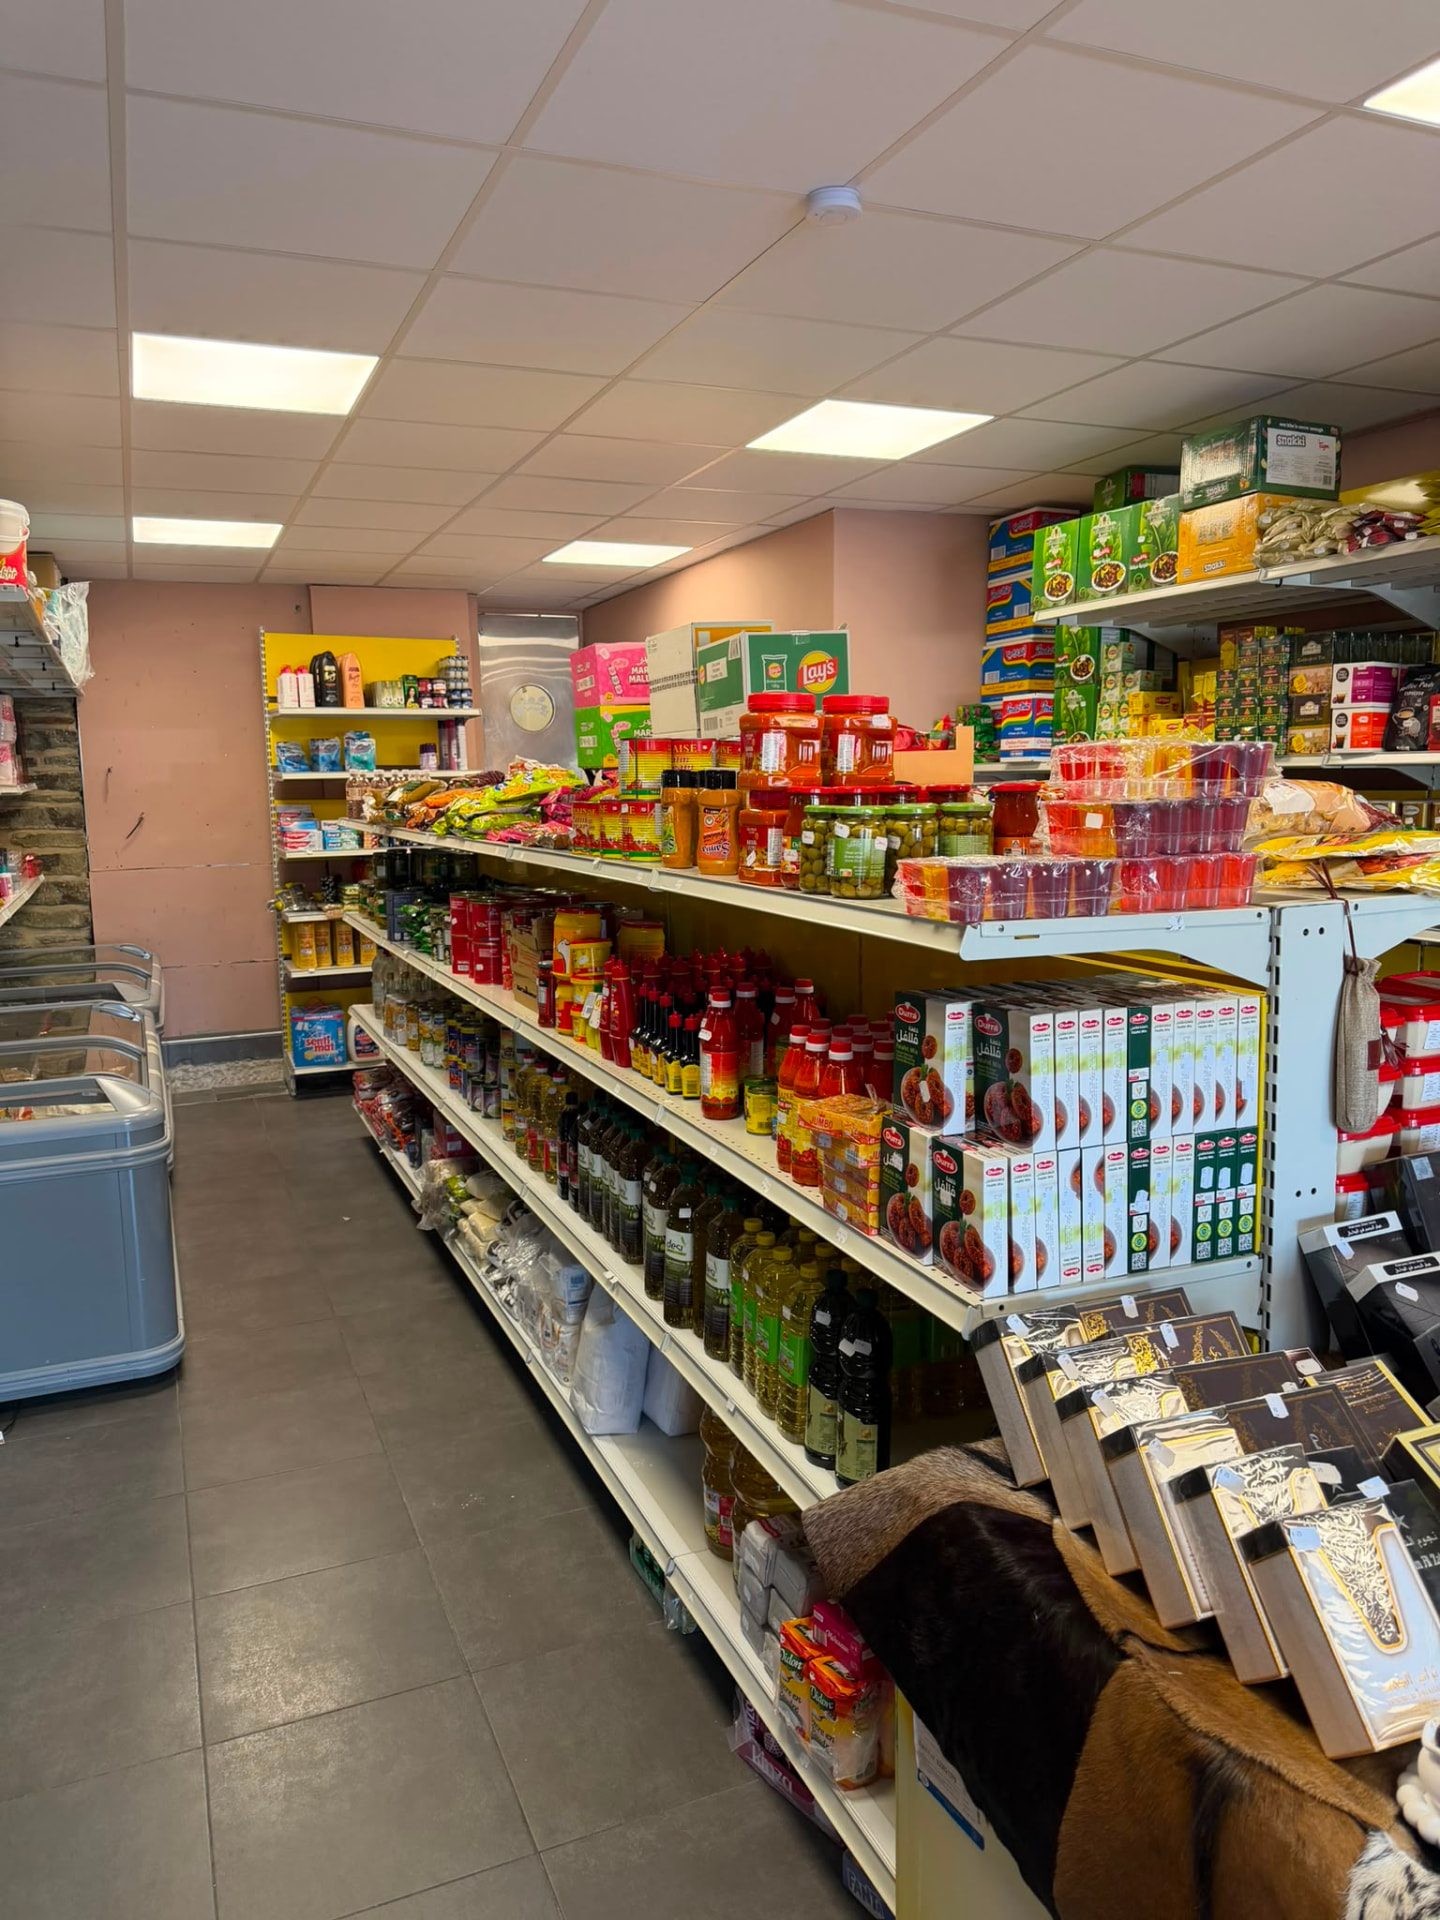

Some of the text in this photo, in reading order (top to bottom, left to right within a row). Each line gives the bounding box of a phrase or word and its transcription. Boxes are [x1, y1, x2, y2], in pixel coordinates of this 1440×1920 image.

[1277, 434, 1306, 447] snakki
[631, 667, 648, 675] MAR
[802, 660, 835, 685] Lay's
[628, 675, 648, 683] MALL
[633, 729, 652, 738] MAR
[898, 1006, 918, 1021] Durra
[977, 1019, 999, 1033] Durra
[896, 1029, 919, 1045] فلافل
[977, 1042, 1001, 1059] فلافل
[809, 1115, 834, 1129] JUMBO
[751, 1744, 793, 1795] kinza
